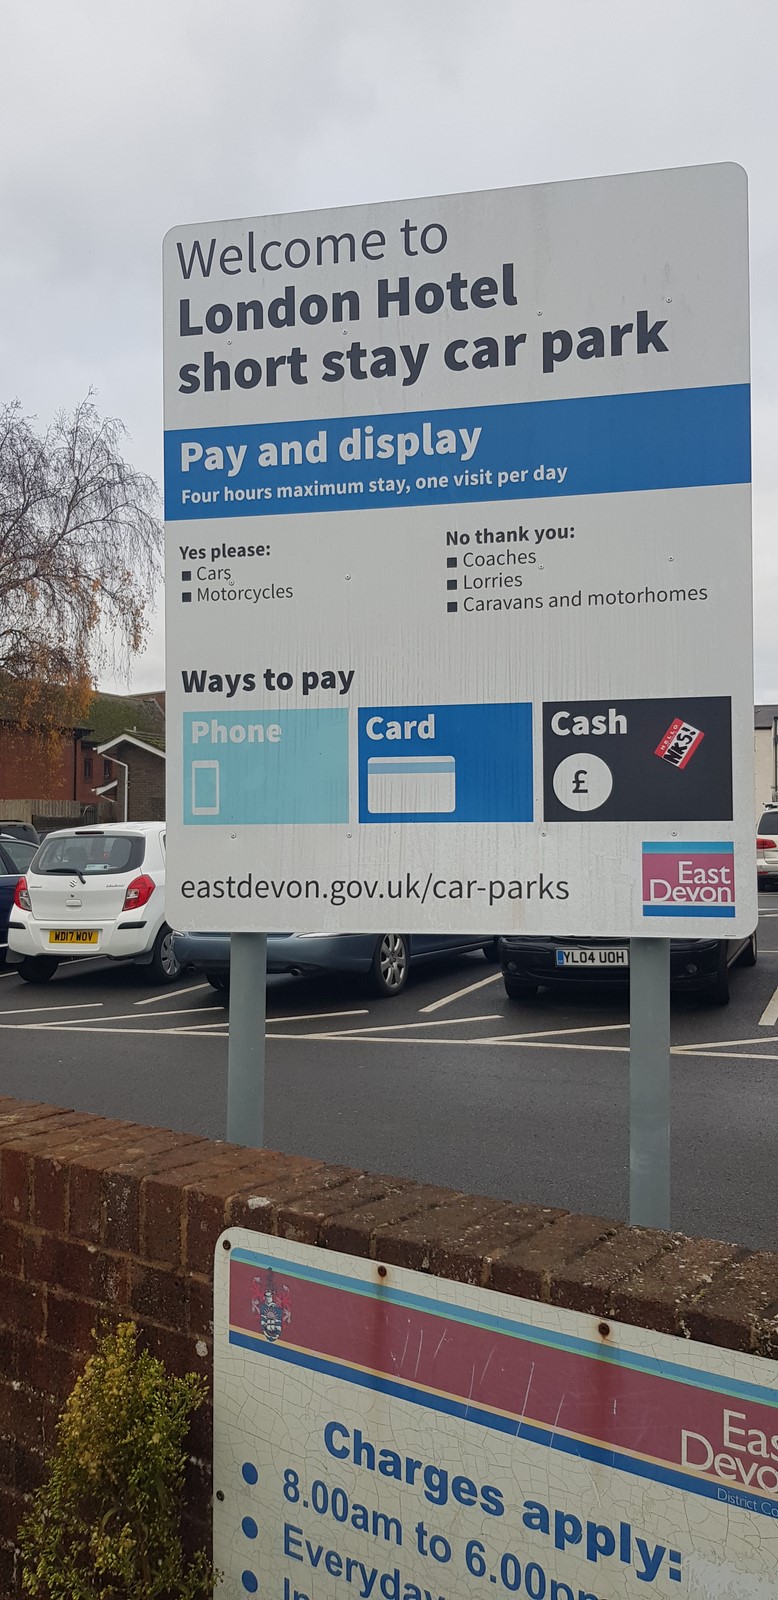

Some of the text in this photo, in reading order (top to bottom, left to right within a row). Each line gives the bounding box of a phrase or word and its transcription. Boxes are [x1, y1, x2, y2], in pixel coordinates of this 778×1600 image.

[176, 219, 447, 279] Welcome to
[179, 263, 518, 336] London Hotel
[178, 310, 669, 394] short stay car park
[181, 422, 483, 477] Pay and display
[182, 465, 568, 504] Four hours maximum stay, one visit per day
[446, 526, 575, 546] No thank you:
[179, 543, 270, 562] Yes please:
[463, 549, 537, 567] Coaches
[197, 566, 231, 581] Cars
[463, 573, 523, 590] Lorries
[197, 583, 293, 603] Motorcycles
[463, 586, 708, 612] Caravans and motorhomes
[181, 668, 355, 697] Ways to pay
[191, 719, 282, 744] Phone
[366, 713, 435, 741] Card
[551, 708, 628, 736] Cash
[660, 724, 678, 751] HELLO
[572, 769, 588, 793] £
[678, 861, 731, 884] East
[181, 873, 570, 905] eastdevon.gov.uk/car-parks
[649, 879, 732, 902] Devon
[54, 930, 93, 941] WD17 WOV
[563, 951, 625, 963] YL04 UOH
[681, 1428, 778, 1493] Devo
[323, 1421, 682, 1582] Charges apply:
[717, 1487, 758, 1511] District
[283, 1469, 403, 1546] 8.00am
[415, 1521, 452, 1563] to
